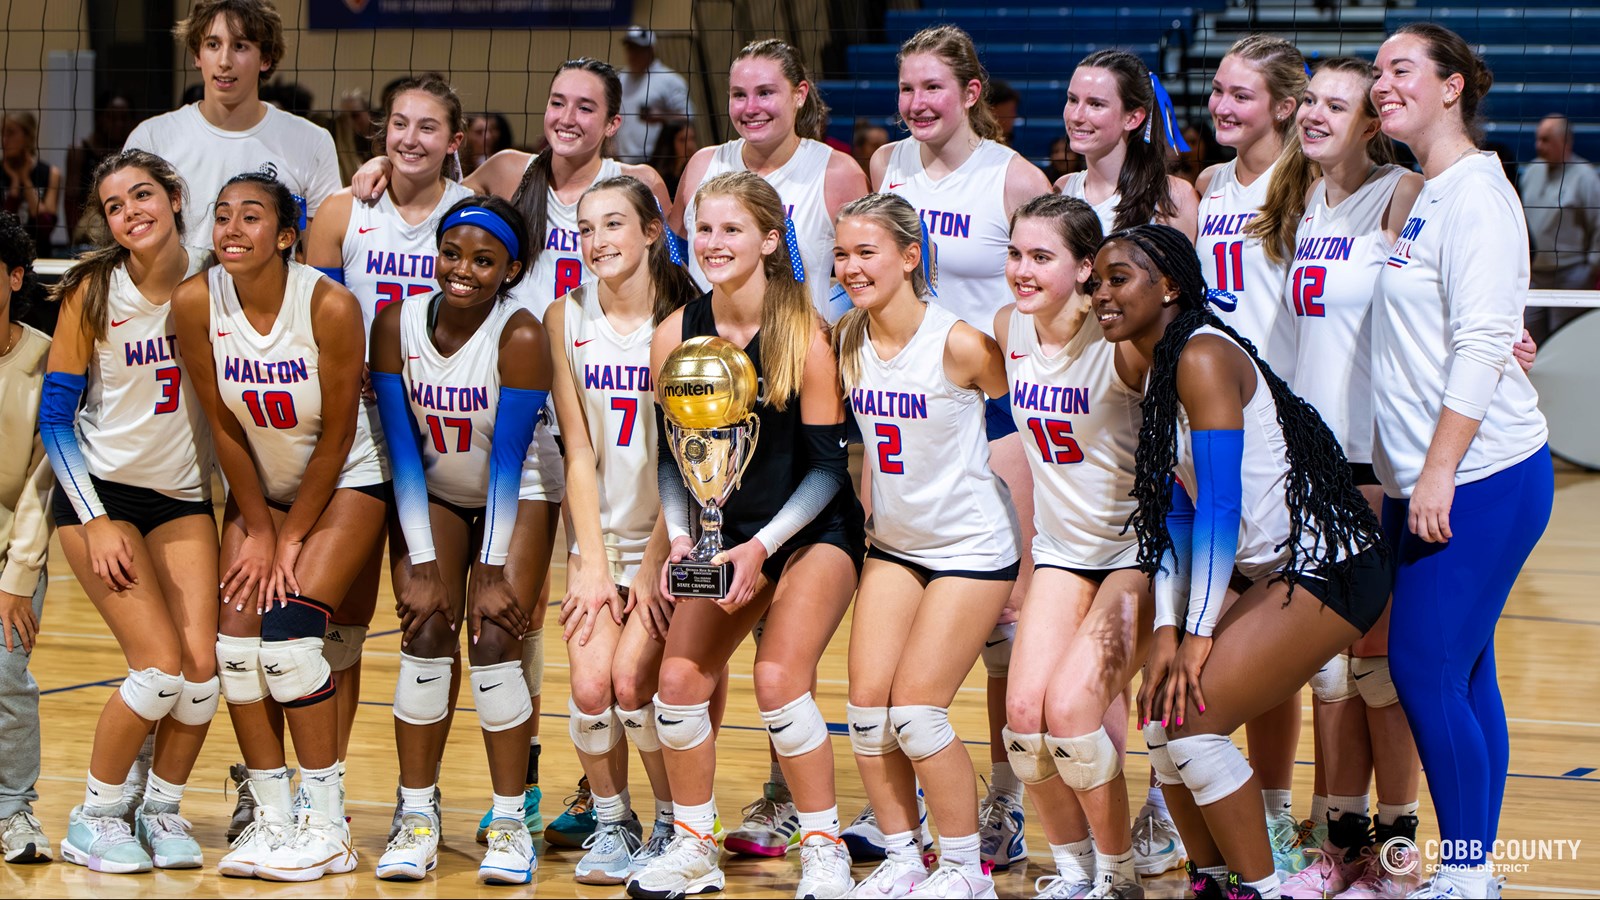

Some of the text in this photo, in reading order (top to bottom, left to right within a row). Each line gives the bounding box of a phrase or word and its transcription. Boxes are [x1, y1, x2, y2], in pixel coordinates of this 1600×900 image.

[545, 227, 581, 252] ALT
[913, 208, 971, 239] TON
[1201, 212, 1260, 237] WALT
[366, 250, 438, 279] WALTO
[1294, 236, 1356, 261] WALTON
[554, 257, 583, 300] 8
[1212, 240, 1245, 292] 11
[374, 281, 434, 317] 2
[1291, 265, 1327, 318] 12
[124, 334, 183, 368] WALT
[225, 355, 309, 385] WALTON
[584, 364, 655, 392] WALTO
[154, 365, 182, 416] 3
[410, 379, 489, 412] WALTON
[664, 383, 715, 397] molten
[851, 387, 928, 419] WALTON
[1013, 380, 1090, 415] WALTON
[242, 390, 299, 430] 10
[610, 396, 638, 447] 7
[425, 414, 473, 454] 17
[874, 422, 905, 475] 2
[1026, 416, 1085, 465] 15
